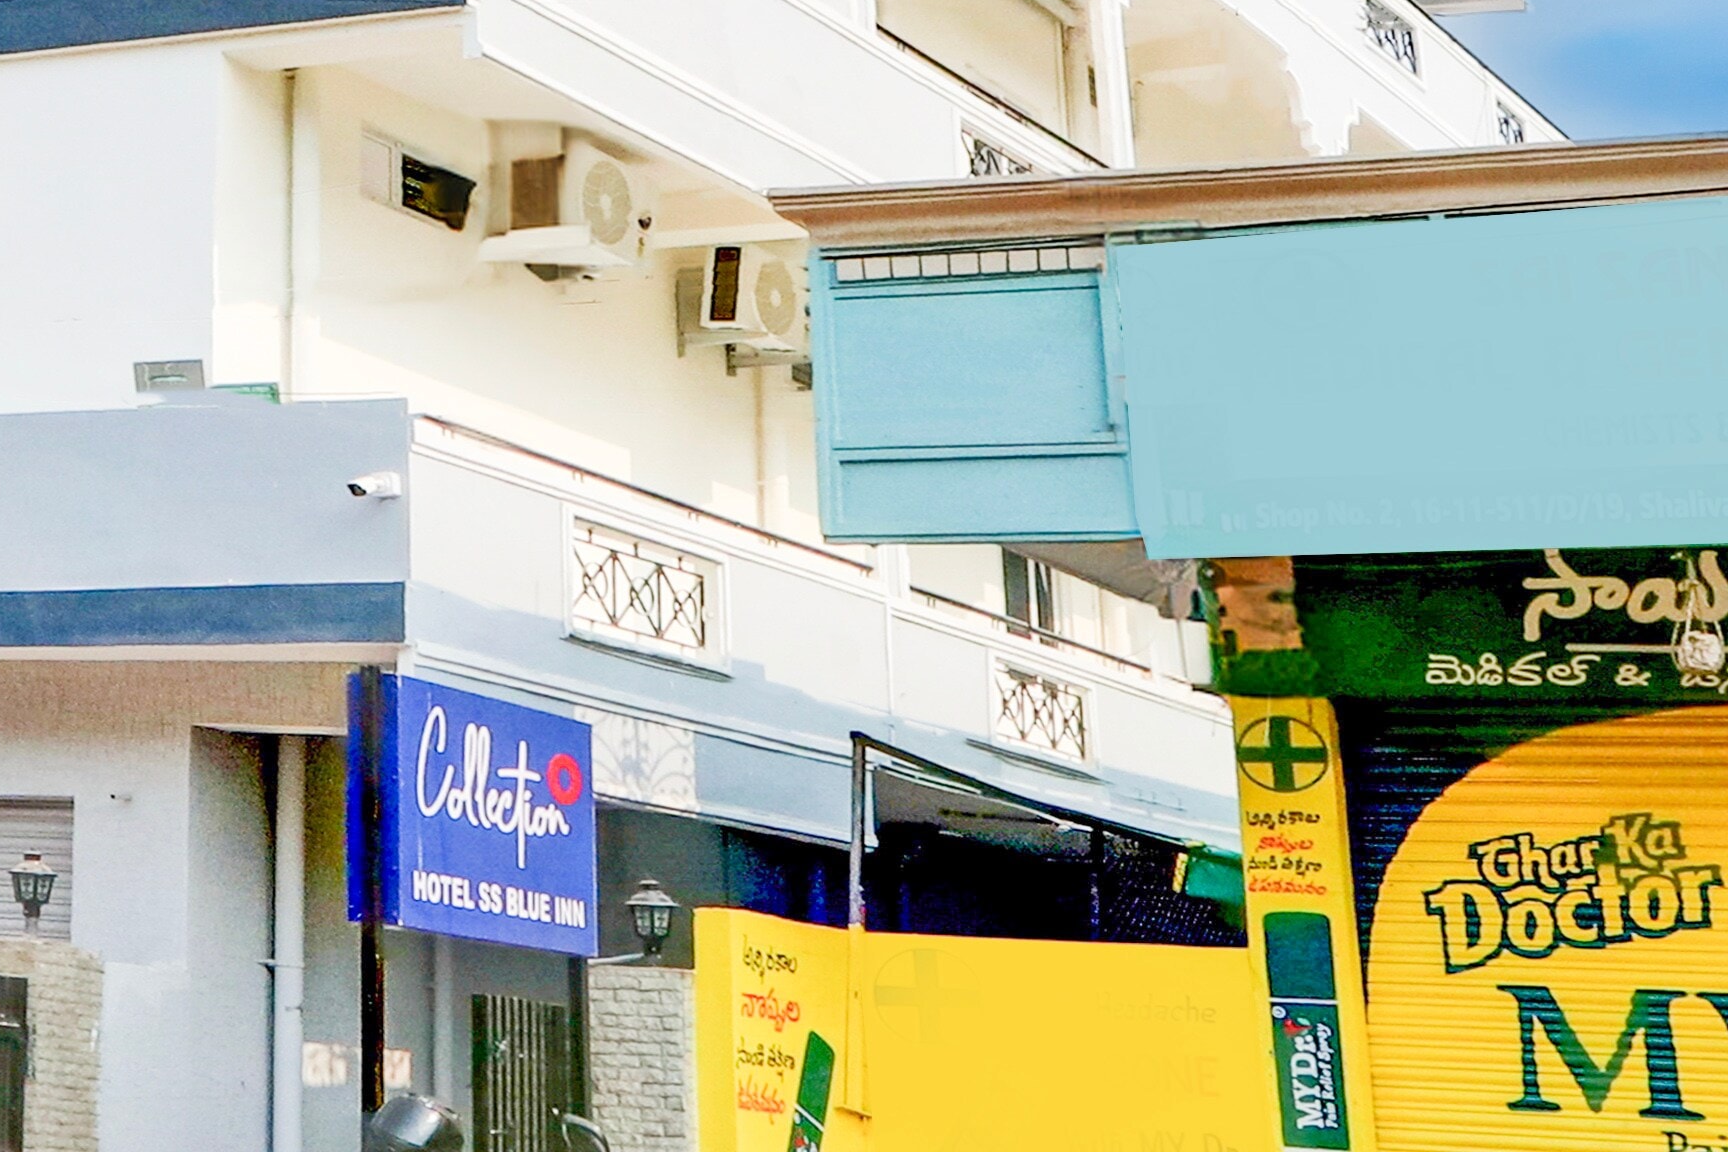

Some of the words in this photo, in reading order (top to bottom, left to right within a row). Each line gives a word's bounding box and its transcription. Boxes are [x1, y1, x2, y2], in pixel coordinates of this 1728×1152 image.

[1425, 651, 1601, 686] మెడికల్
[1614, 664, 1652, 686] &
[417, 706, 570, 869] Collection
[1467, 832, 1604, 890] Ghar
[1600, 812, 1686, 868] Ka
[412, 870, 475, 910] HOTEL
[477, 882, 504, 915] SS
[505, 887, 552, 924] BLUE
[554, 897, 586, 929] INN
[1423, 865, 1725, 974] Doctor
[1290, 1034, 1319, 1079] Dr.
[1291, 1078, 1325, 1129] MY
